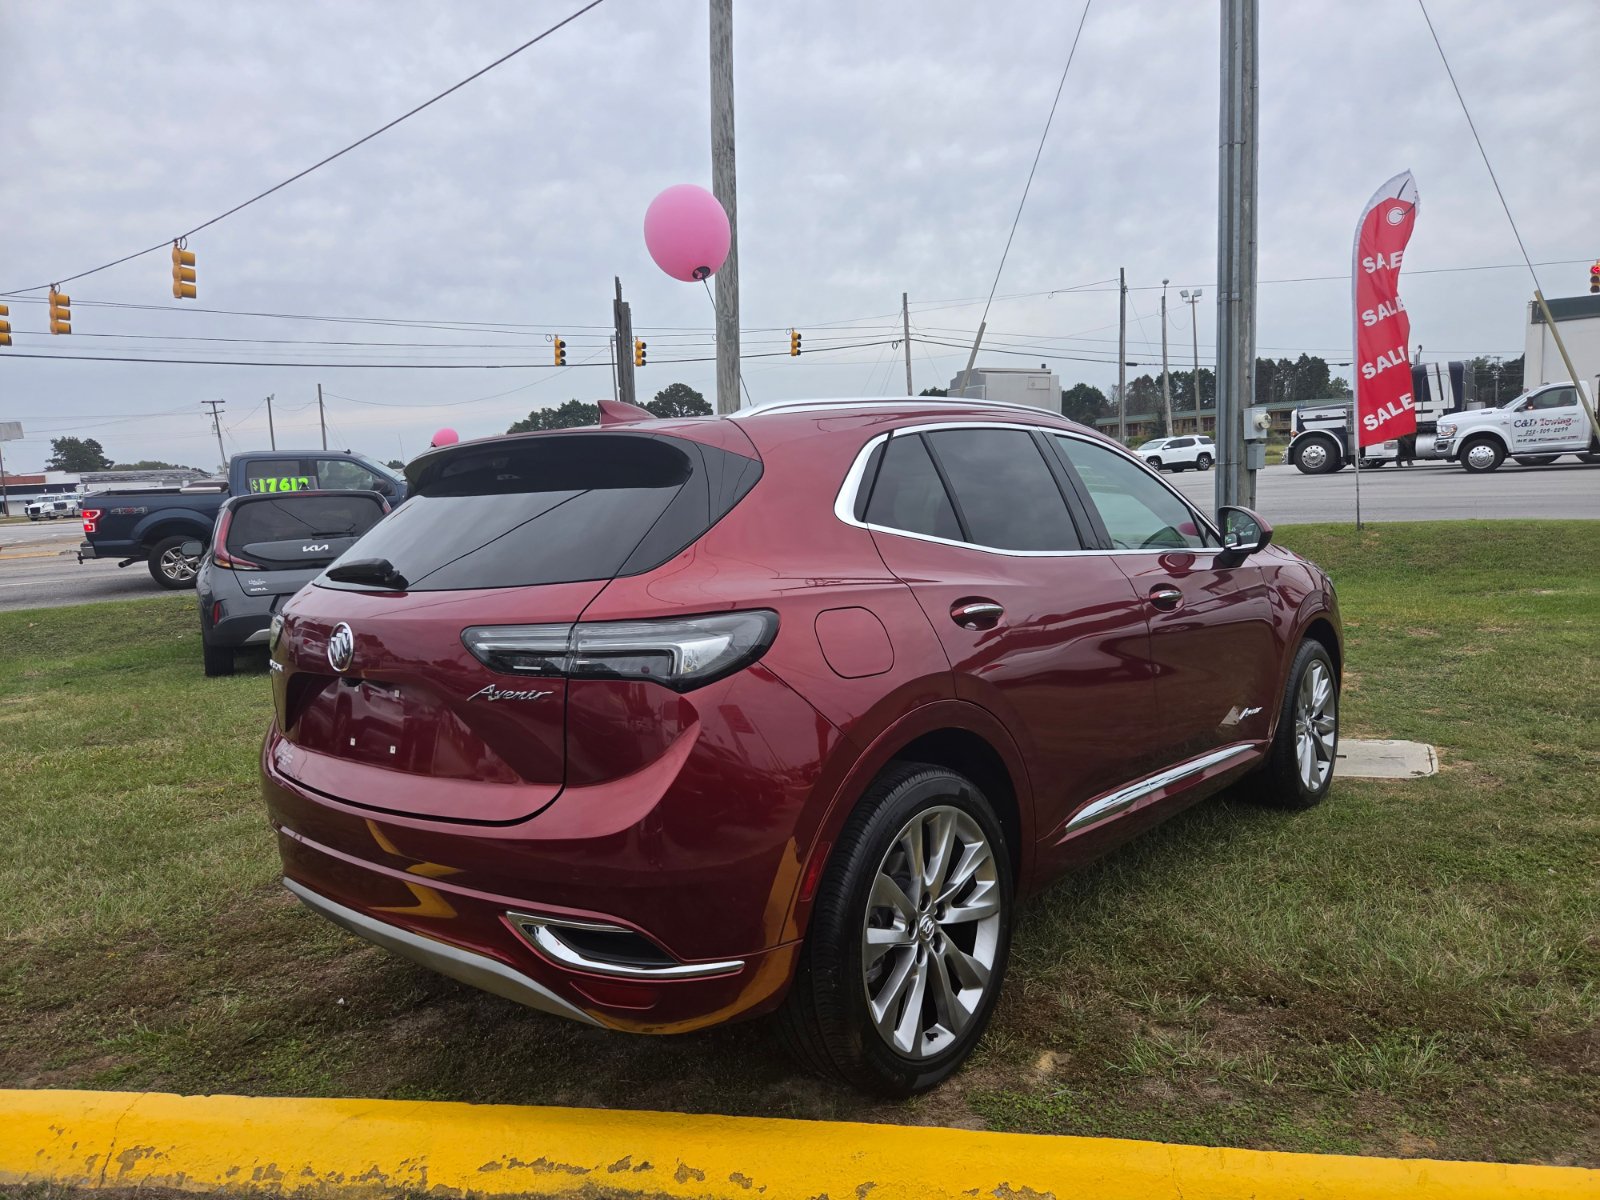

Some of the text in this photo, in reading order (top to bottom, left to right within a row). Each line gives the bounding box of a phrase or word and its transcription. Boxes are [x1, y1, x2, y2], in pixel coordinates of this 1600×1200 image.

[1363, 392, 1415, 431] SALE
[1514, 418, 1537, 428] C&D
[1540, 417, 1572, 426] Towing
[302, 544, 329, 552] KIA
[466, 683, 554, 702] Avenir
